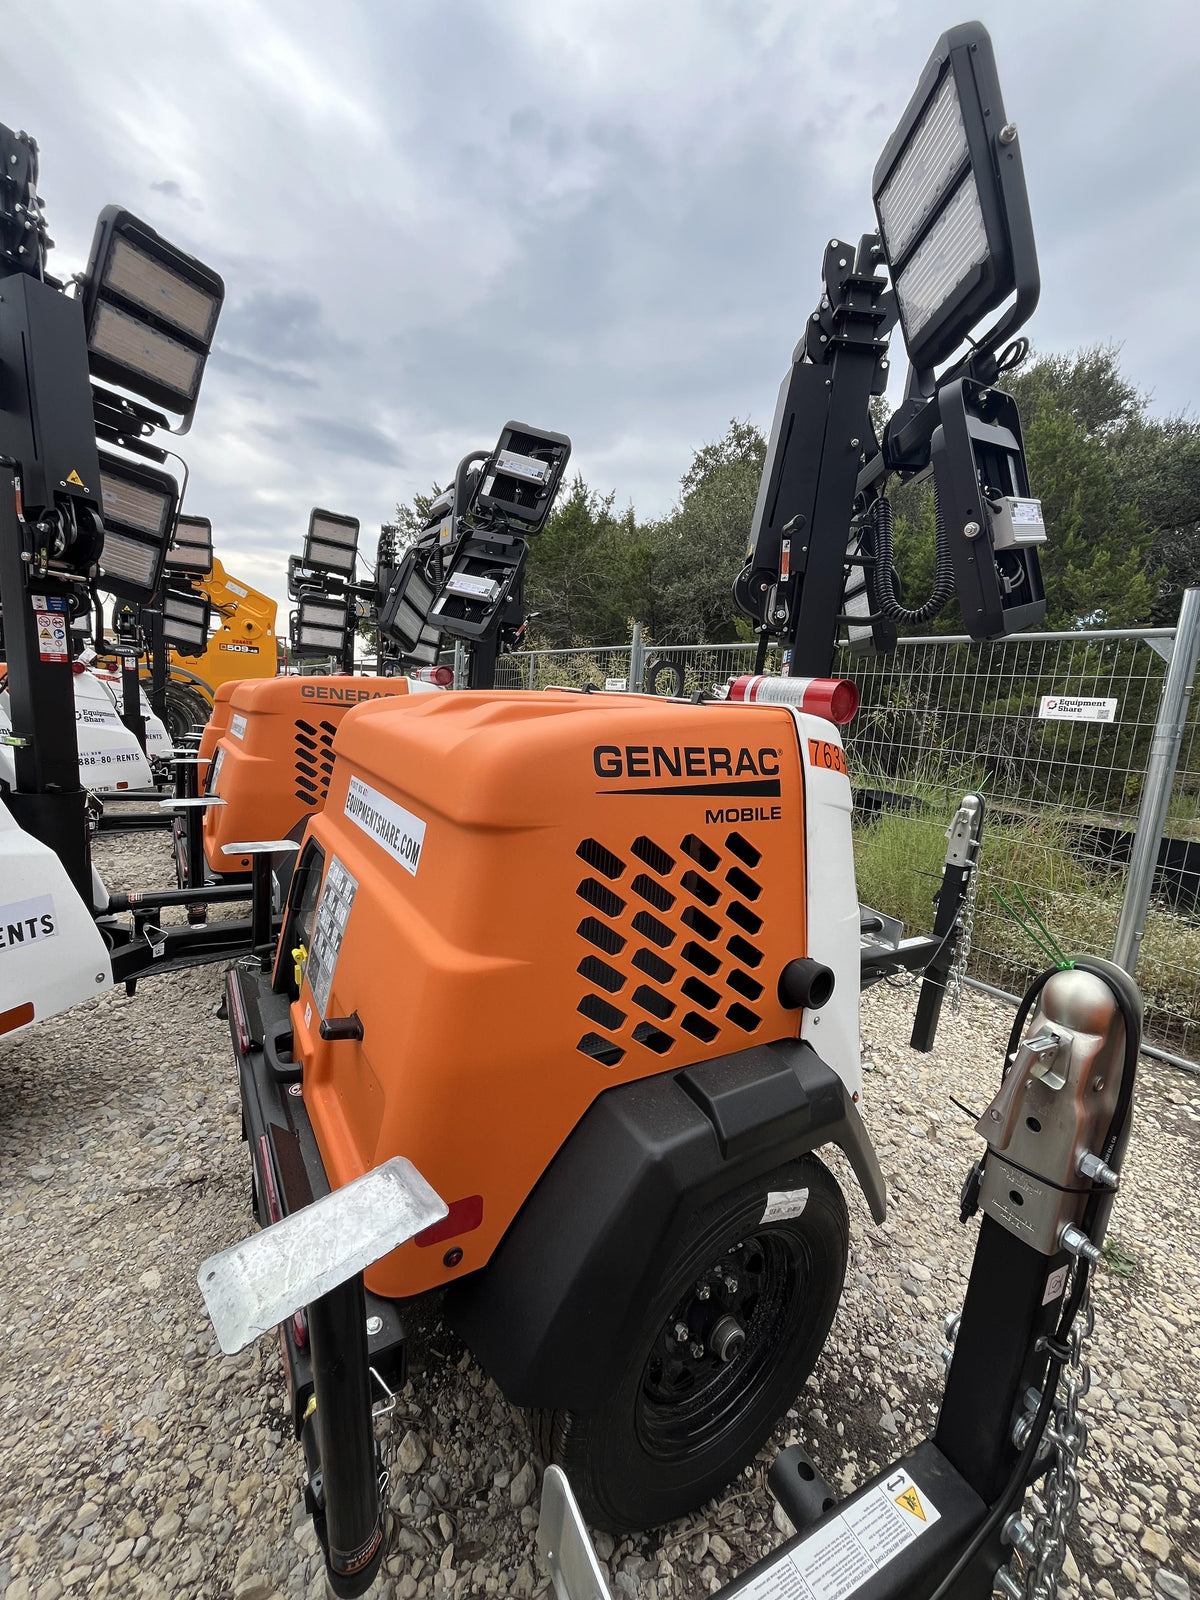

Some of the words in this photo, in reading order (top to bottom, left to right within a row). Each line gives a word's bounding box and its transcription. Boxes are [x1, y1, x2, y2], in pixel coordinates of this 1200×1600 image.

[1059, 699, 1106, 707] Equipment
[82, 709, 117, 719] Equipment
[1058, 705, 1082, 713] Share
[83, 715, 105, 723] Share
[593, 745, 780, 778] GENERAC
[705, 806, 782, 824] MOBILE
[346, 792, 421, 867] EQUIPMENTSHARE.COM
